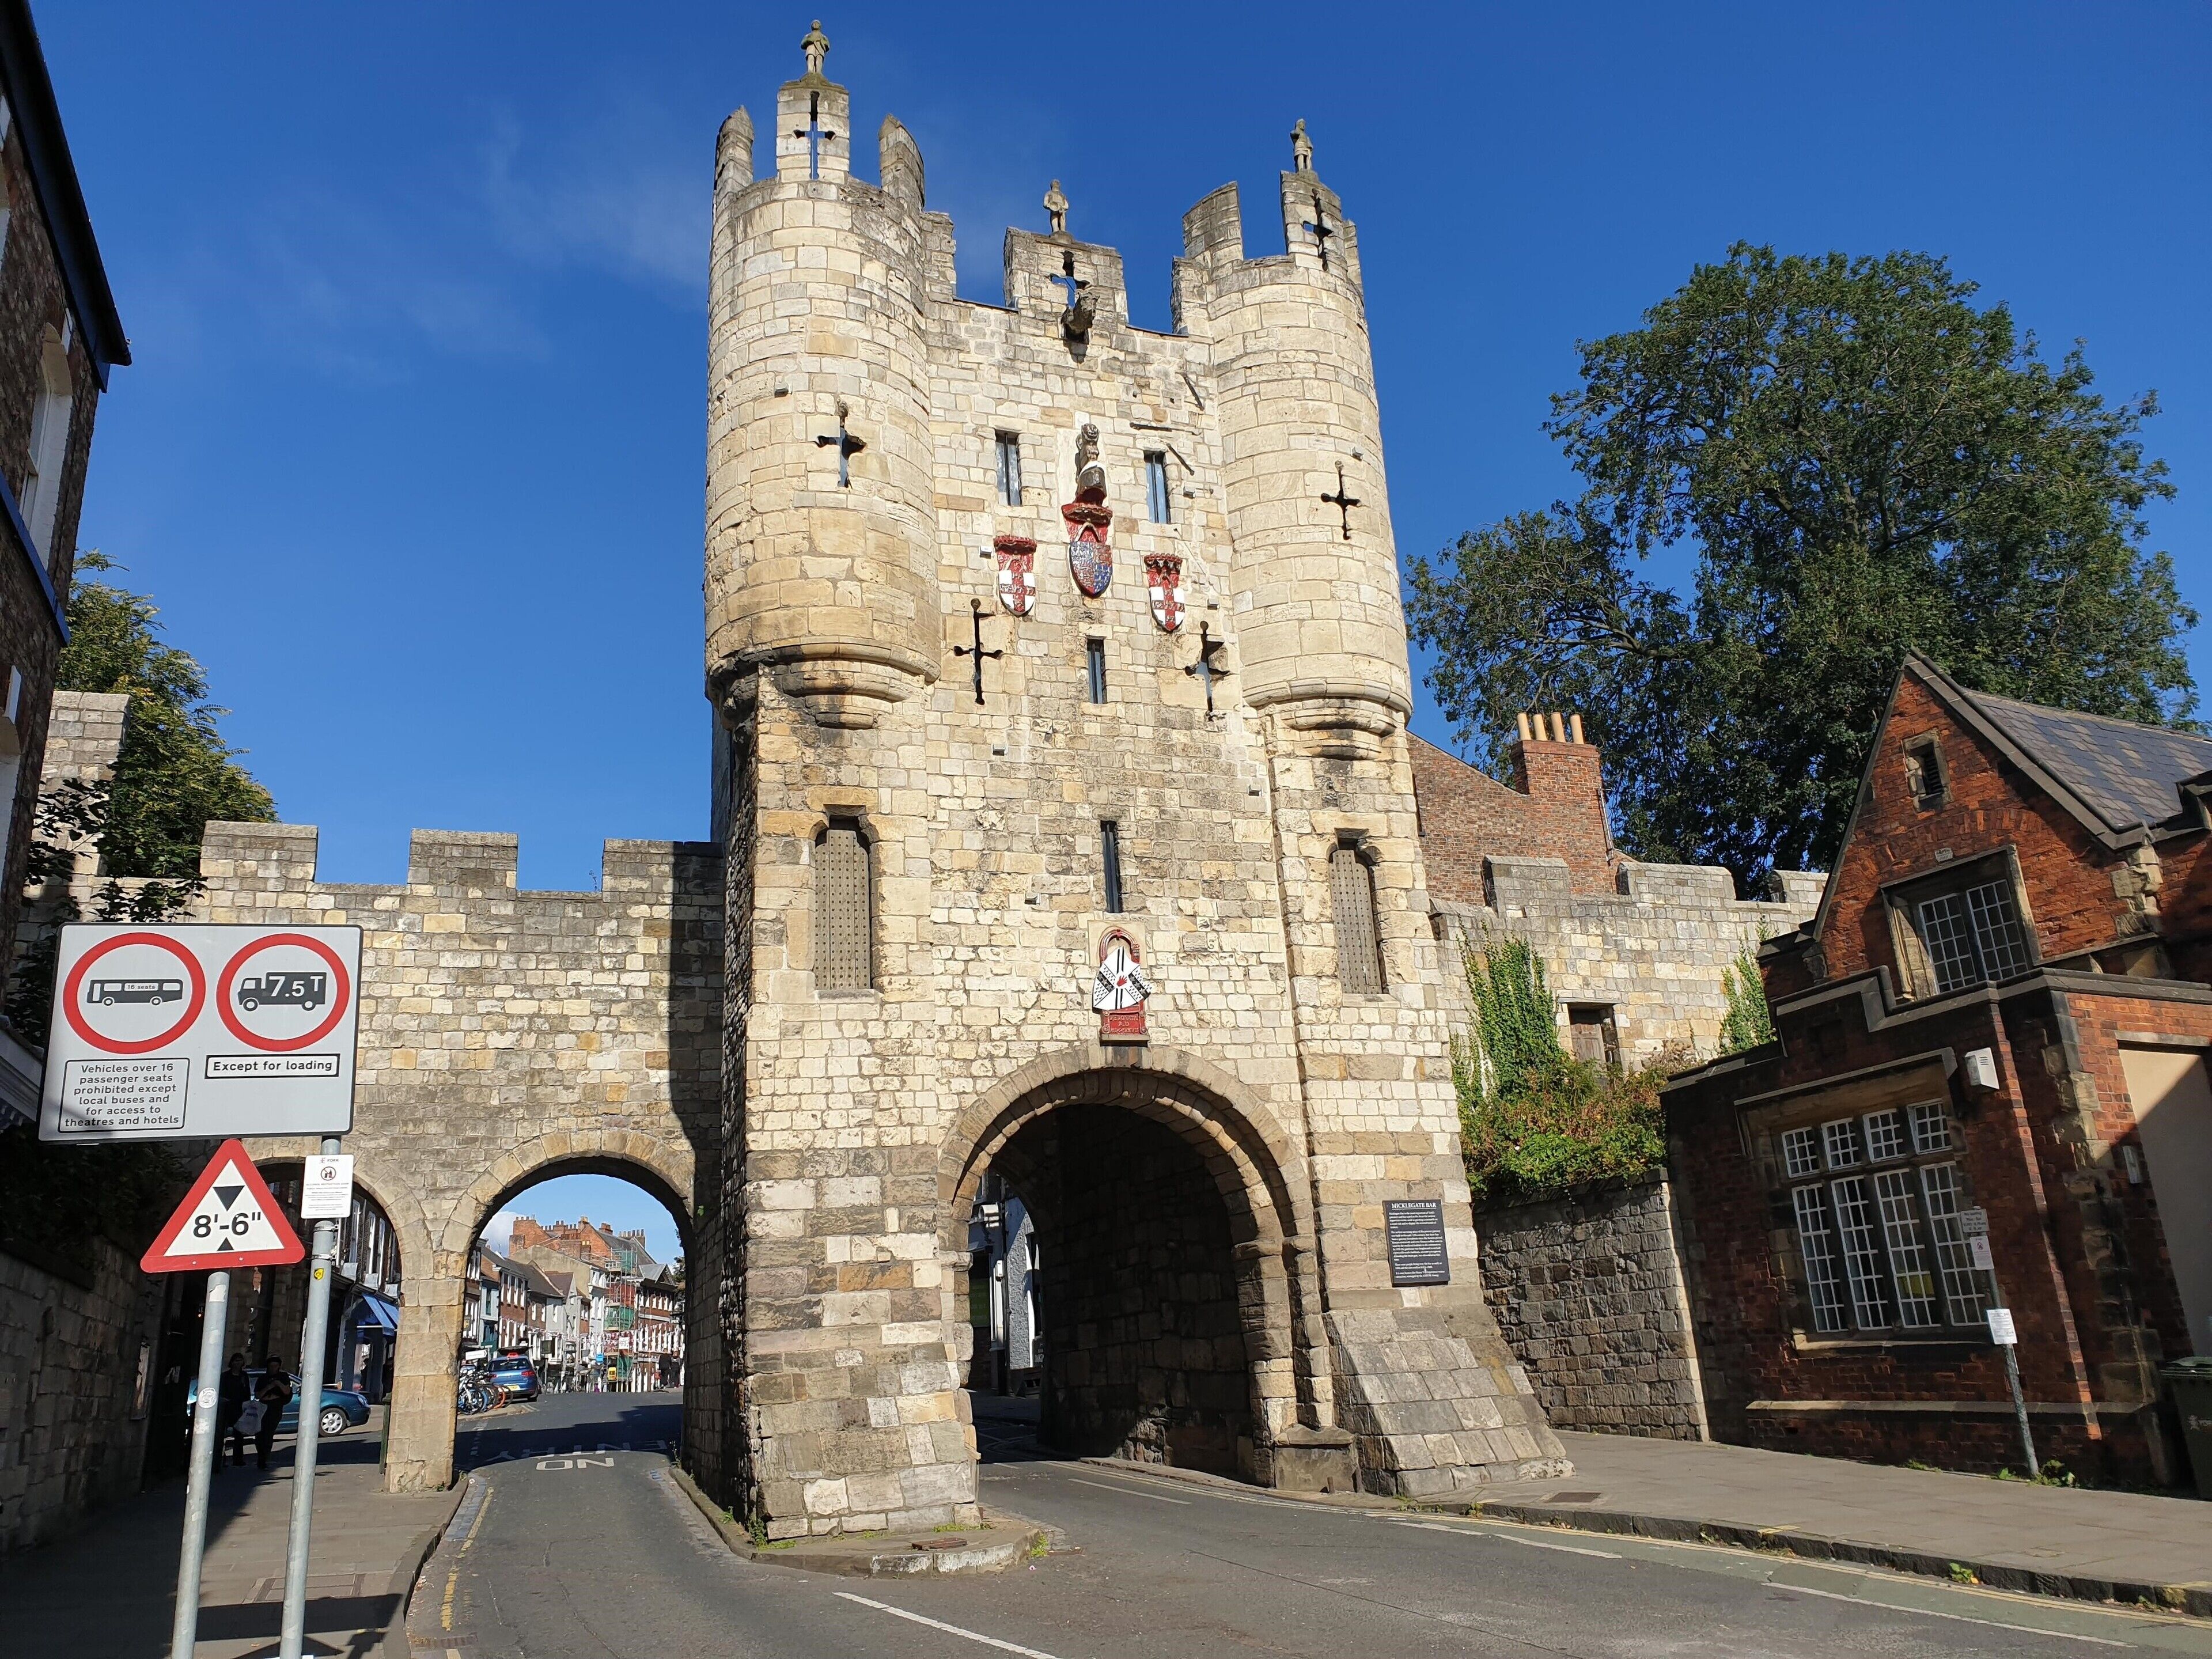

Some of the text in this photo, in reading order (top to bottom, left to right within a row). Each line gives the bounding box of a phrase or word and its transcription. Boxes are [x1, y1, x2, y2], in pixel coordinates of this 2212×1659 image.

[81, 1065, 128, 1073] Vehicles
[162, 1063, 173, 1071] 16
[213, 1060, 332, 1073] Except for loading
[79, 1074, 173, 1085] passenger seats
[74, 1084, 176, 1096] prohibited except
[79, 1094, 169, 1105] local buses and
[86, 1107, 103, 1115] for
[150, 1105, 160, 1113] to
[65, 1115, 179, 1127] theatres and hotels
[535, 1457, 615, 1471] NO
